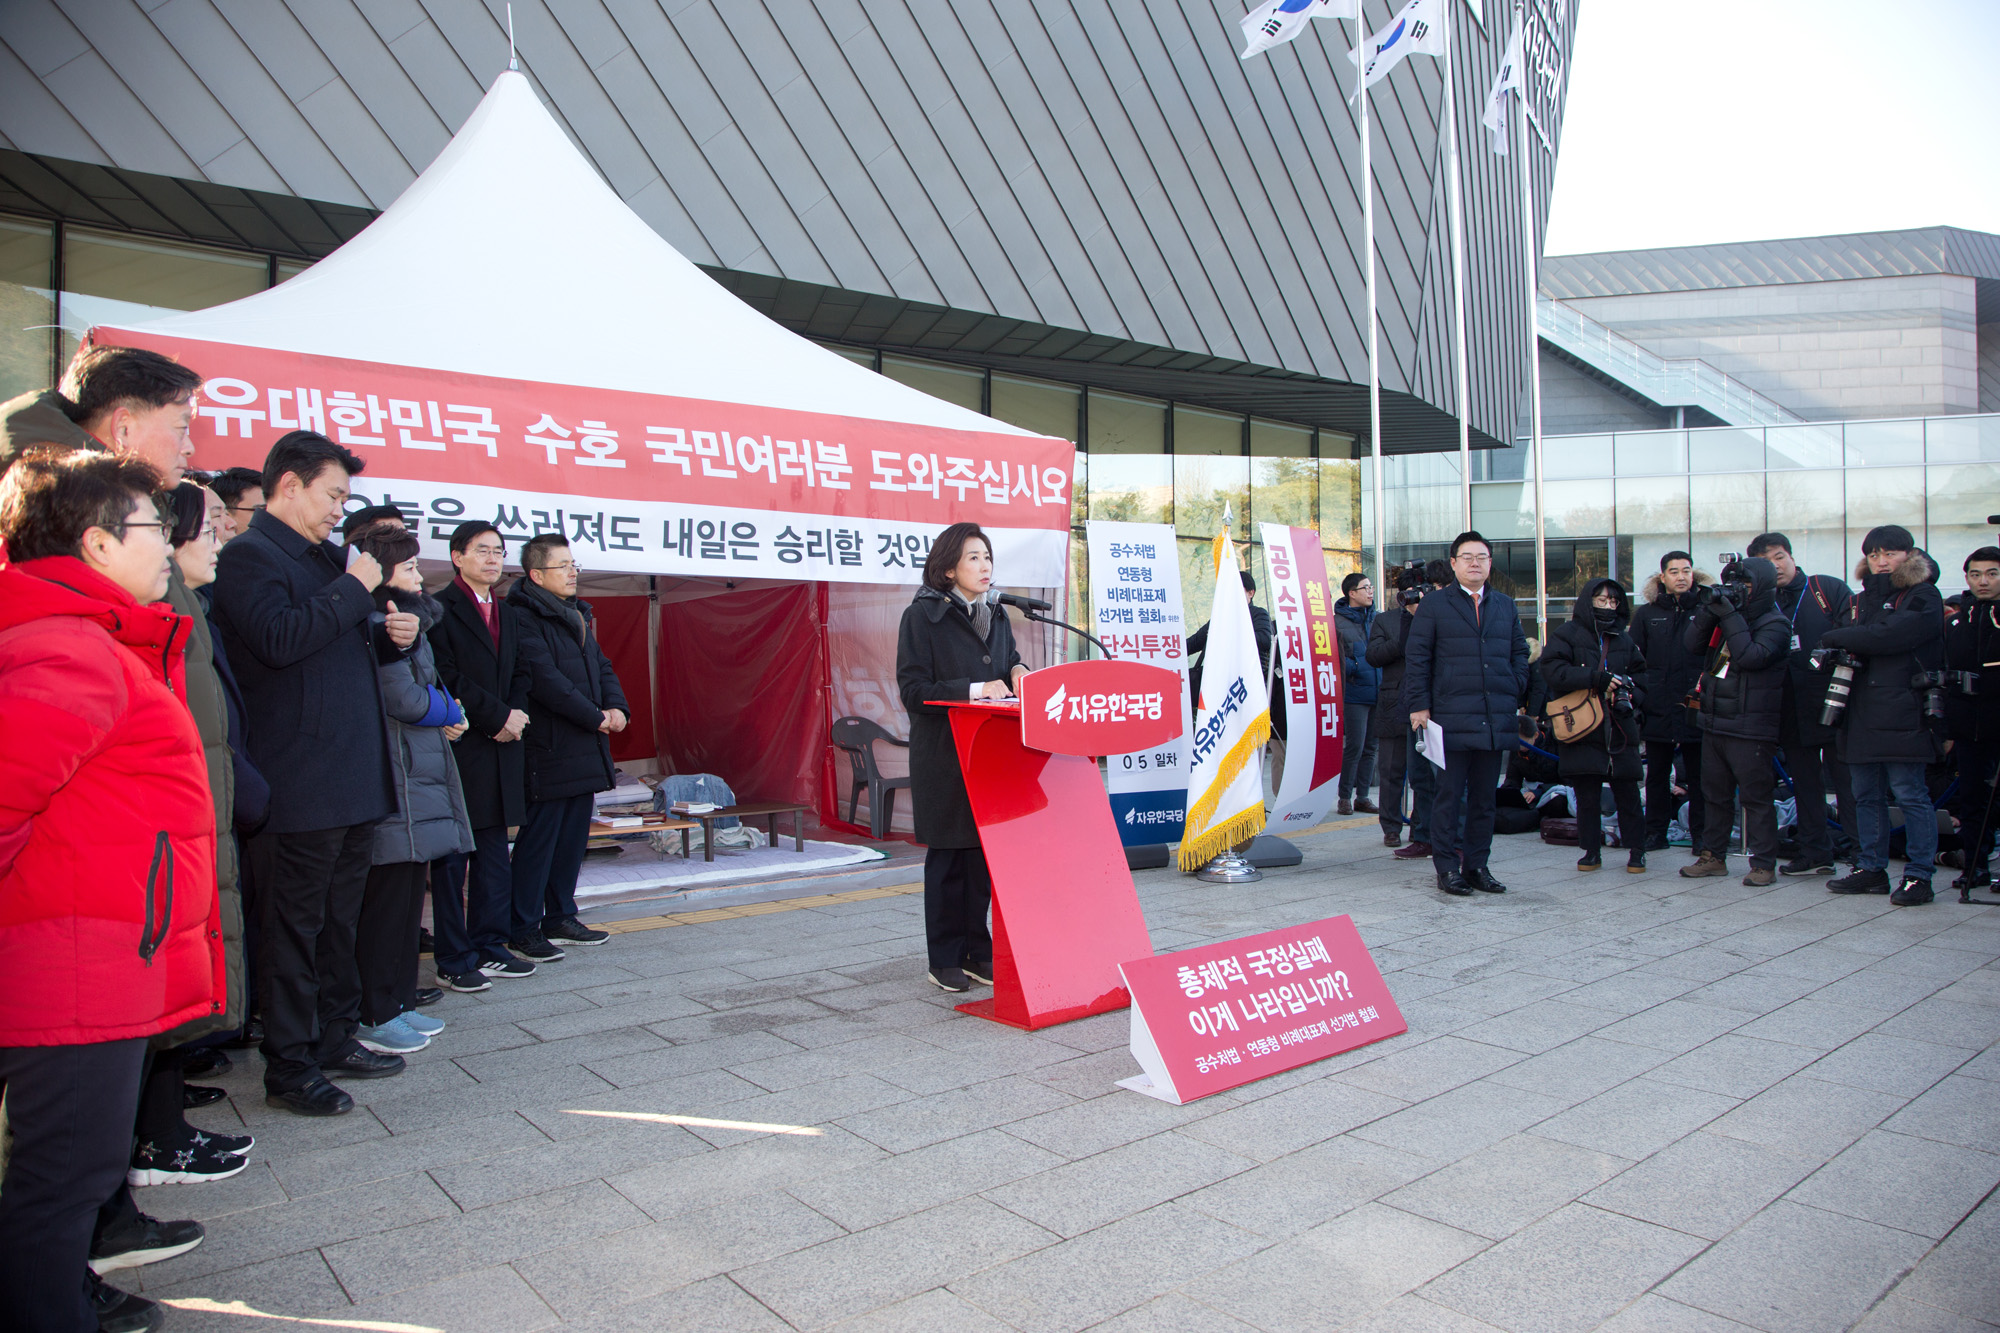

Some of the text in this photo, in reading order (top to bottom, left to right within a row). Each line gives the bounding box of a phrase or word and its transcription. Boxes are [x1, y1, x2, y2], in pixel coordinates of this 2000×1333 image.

[187, 377, 1067, 507] 유대한민국 수호 국민여러분 도와주십시오
[490, 503, 644, 553] 쓰러져도
[662, 517, 759, 561] 내일은
[773, 525, 863, 567] 승리할
[877, 533, 937, 569] 것입
[1109, 543, 1156, 559] 공수처법
[1117, 566, 1153, 582] 연동형
[1107, 587, 1167, 603] 비례대표제
[1815, 591, 1827, 609] Canon
[1098, 607, 1134, 624] 선거법
[1269, 544, 1309, 705] 공수처법
[1100, 634, 1182, 659] 단식투쟁
[1305, 580, 1339, 739] 철회하라
[1068, 691, 1163, 723] 자유한국당
[1136, 809, 1184, 825] 자유한국당
[1176, 935, 1332, 999] 총체적 국정실패
[1188, 970, 1354, 1038] 이게 나라입니까?
[1194, 1004, 1380, 1075] 공수처법 연동형 비례대표제 선거법 철회
